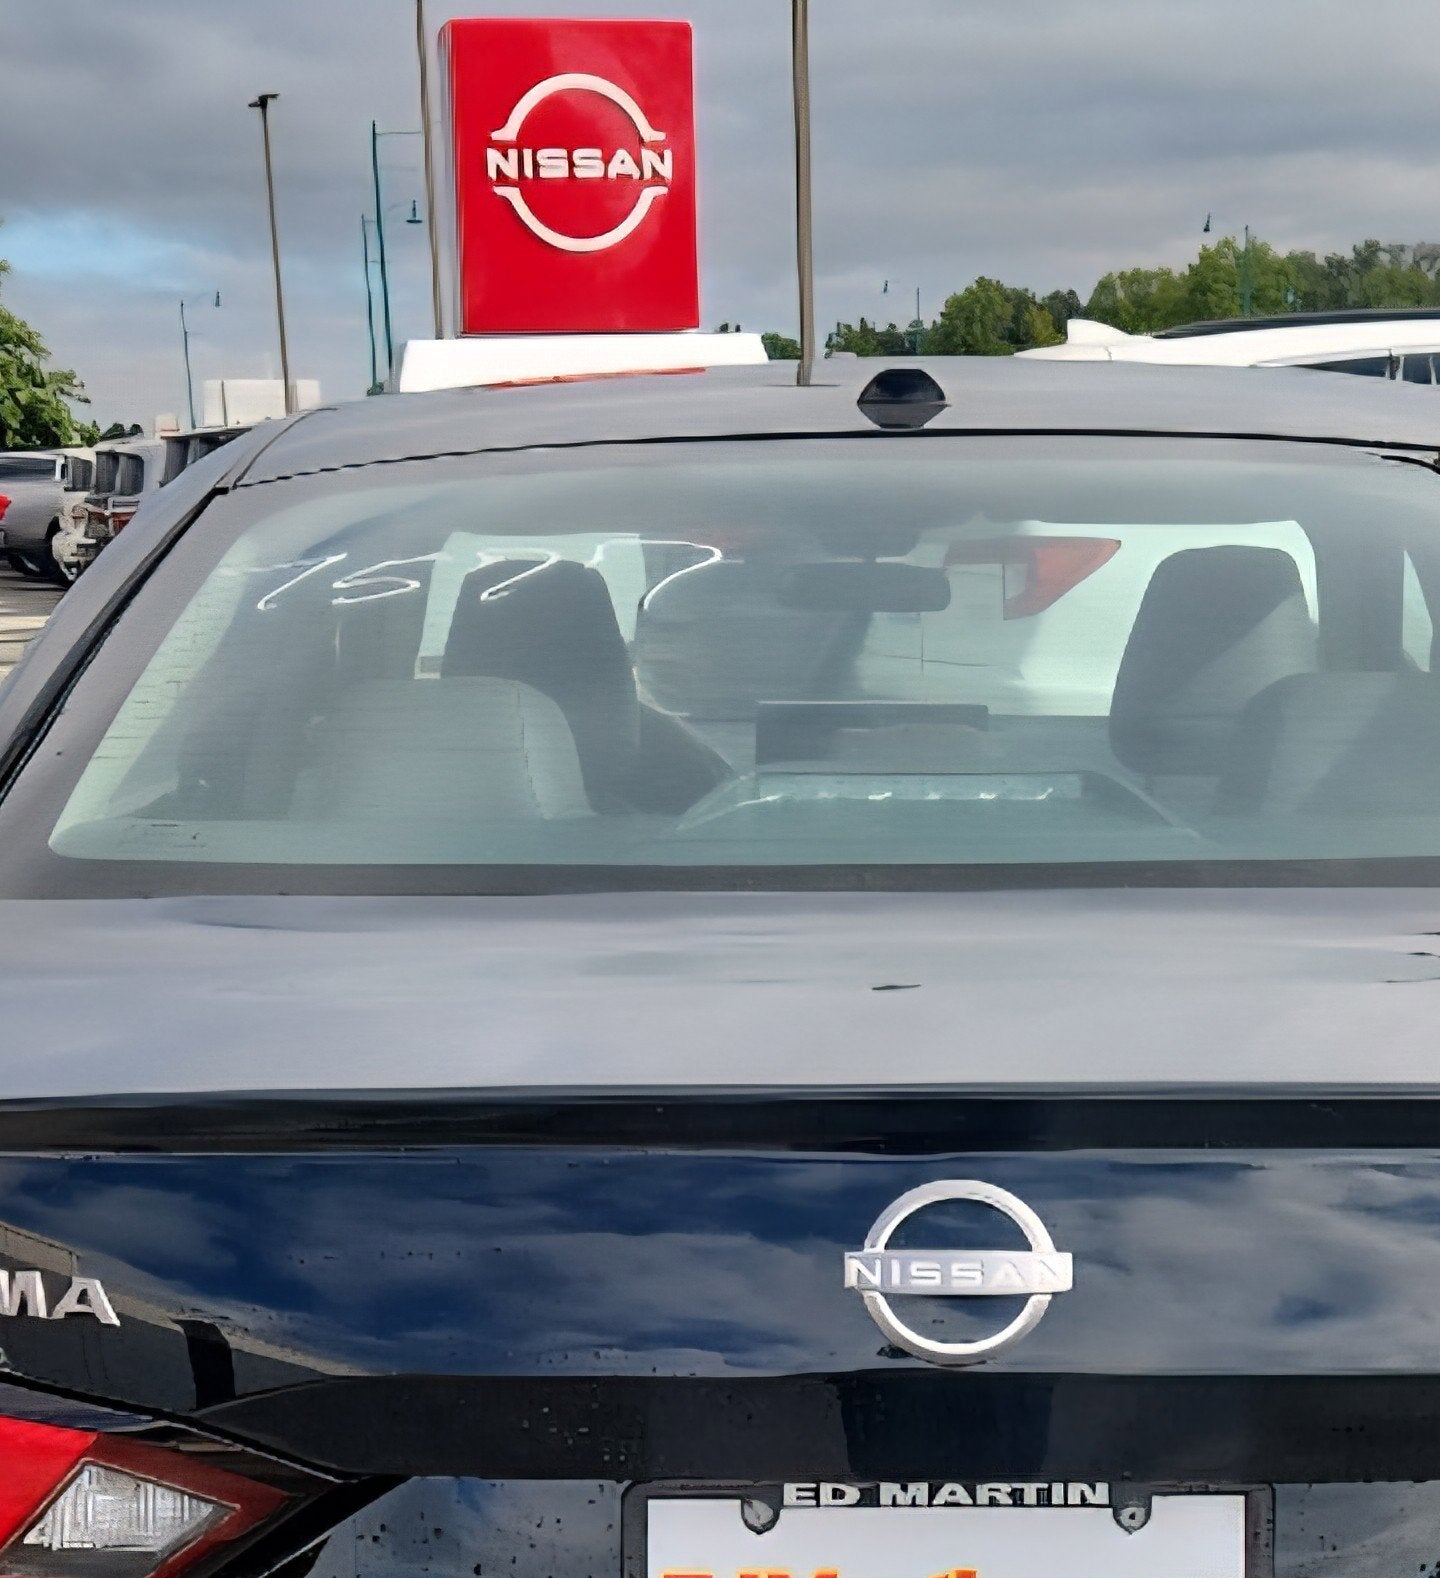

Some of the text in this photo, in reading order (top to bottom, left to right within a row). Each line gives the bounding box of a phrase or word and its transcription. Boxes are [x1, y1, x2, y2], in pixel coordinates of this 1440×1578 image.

[486, 147, 672, 181] NISSAN
[844, 1254, 1069, 1289] NISSAN
[781, 1482, 1111, 1508] ED MARTIN
